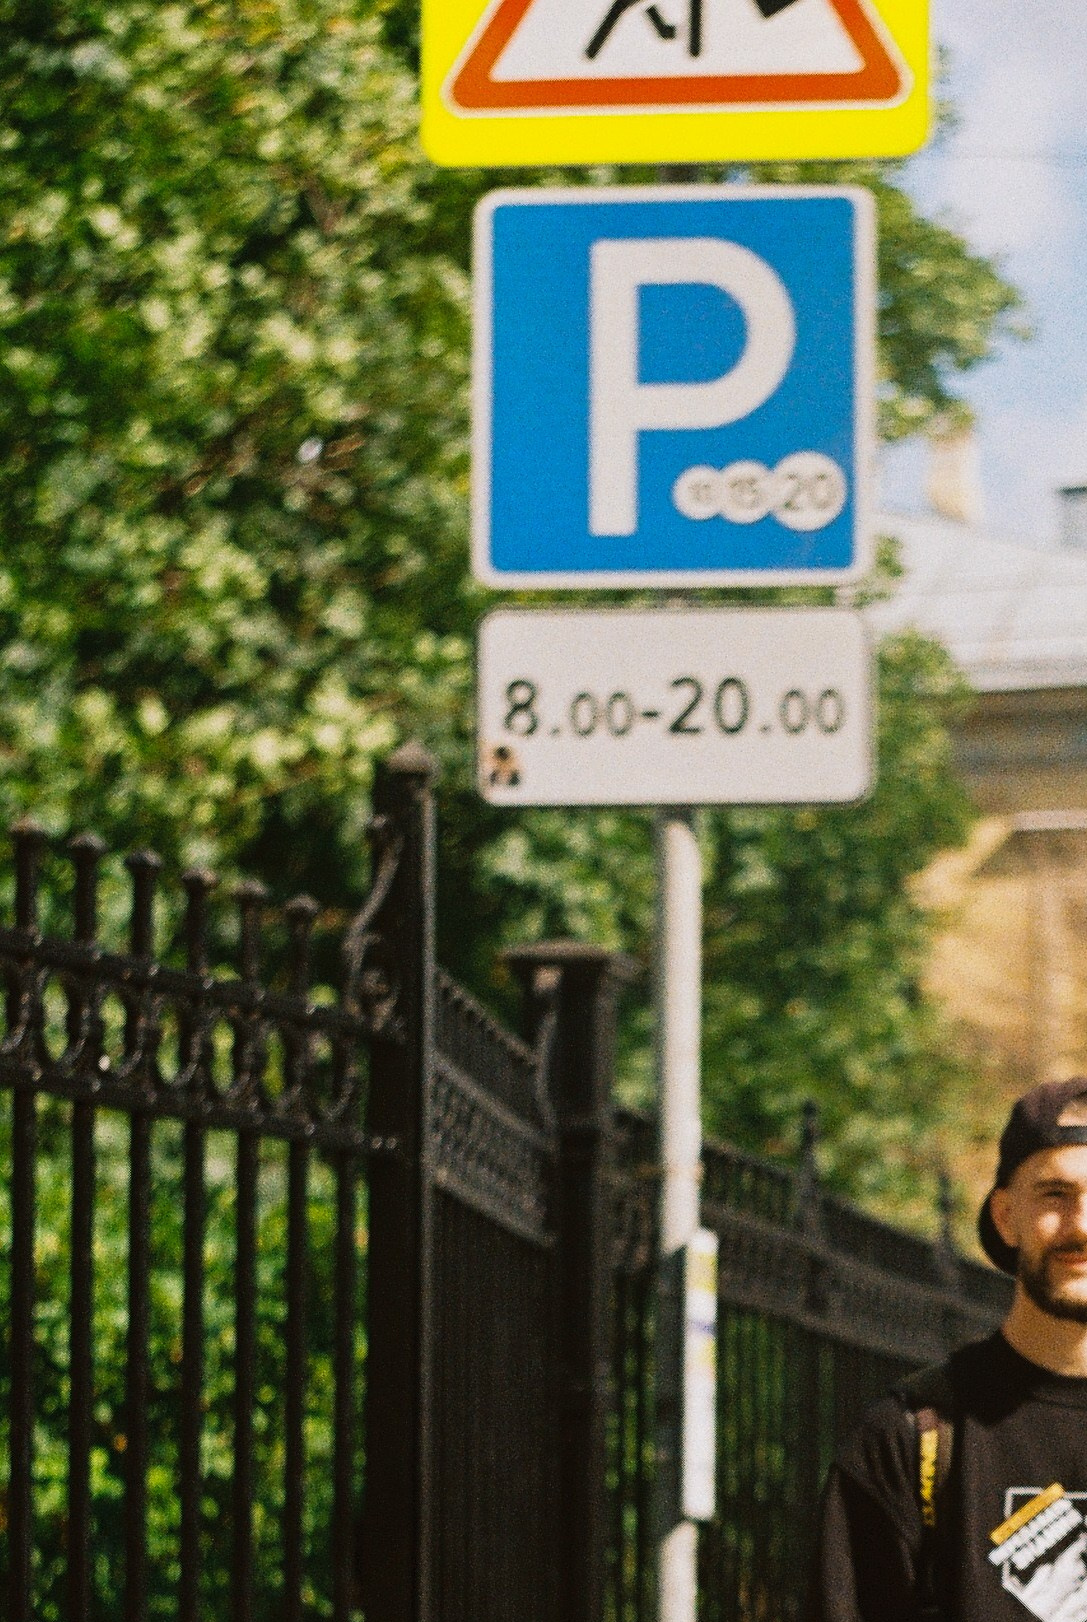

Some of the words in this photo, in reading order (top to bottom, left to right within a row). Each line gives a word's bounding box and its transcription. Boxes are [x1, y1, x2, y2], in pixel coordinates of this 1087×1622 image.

[590, 238, 796, 536] P
[783, 472, 836, 511] 20
[502, 676, 844, 737] 8.00-20.00
